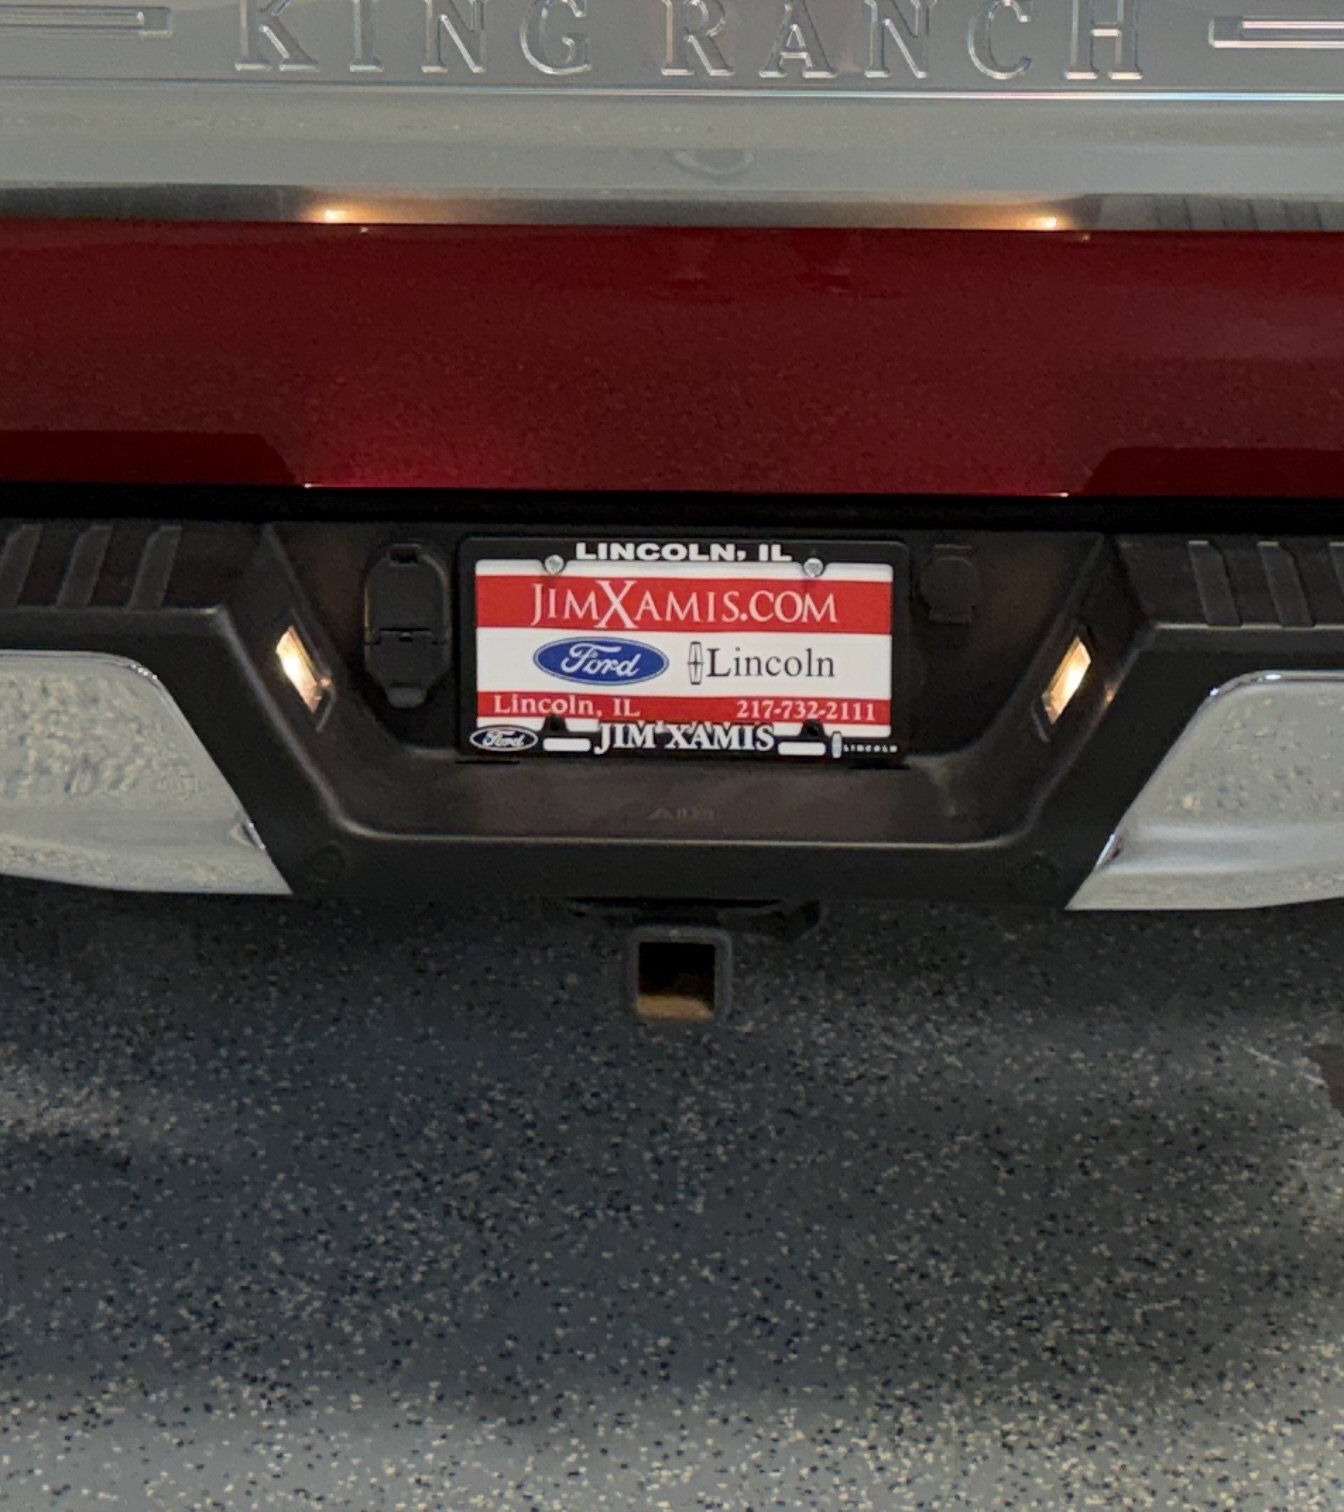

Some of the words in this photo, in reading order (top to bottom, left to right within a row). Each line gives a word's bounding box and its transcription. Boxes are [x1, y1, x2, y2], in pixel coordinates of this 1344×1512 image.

[575, 542, 747, 562] LINCOLN,
[758, 544, 792, 562] IL
[531, 580, 838, 629] JIMXAMIS.COM
[560, 645, 641, 677] Ford
[706, 648, 835, 678] Lincoln
[493, 695, 602, 717] Lincoln,
[613, 698, 640, 717] IL
[736, 699, 875, 721] 217-732-2111
[594, 722, 657, 755] JIM
[665, 723, 775, 752] XAMIS
